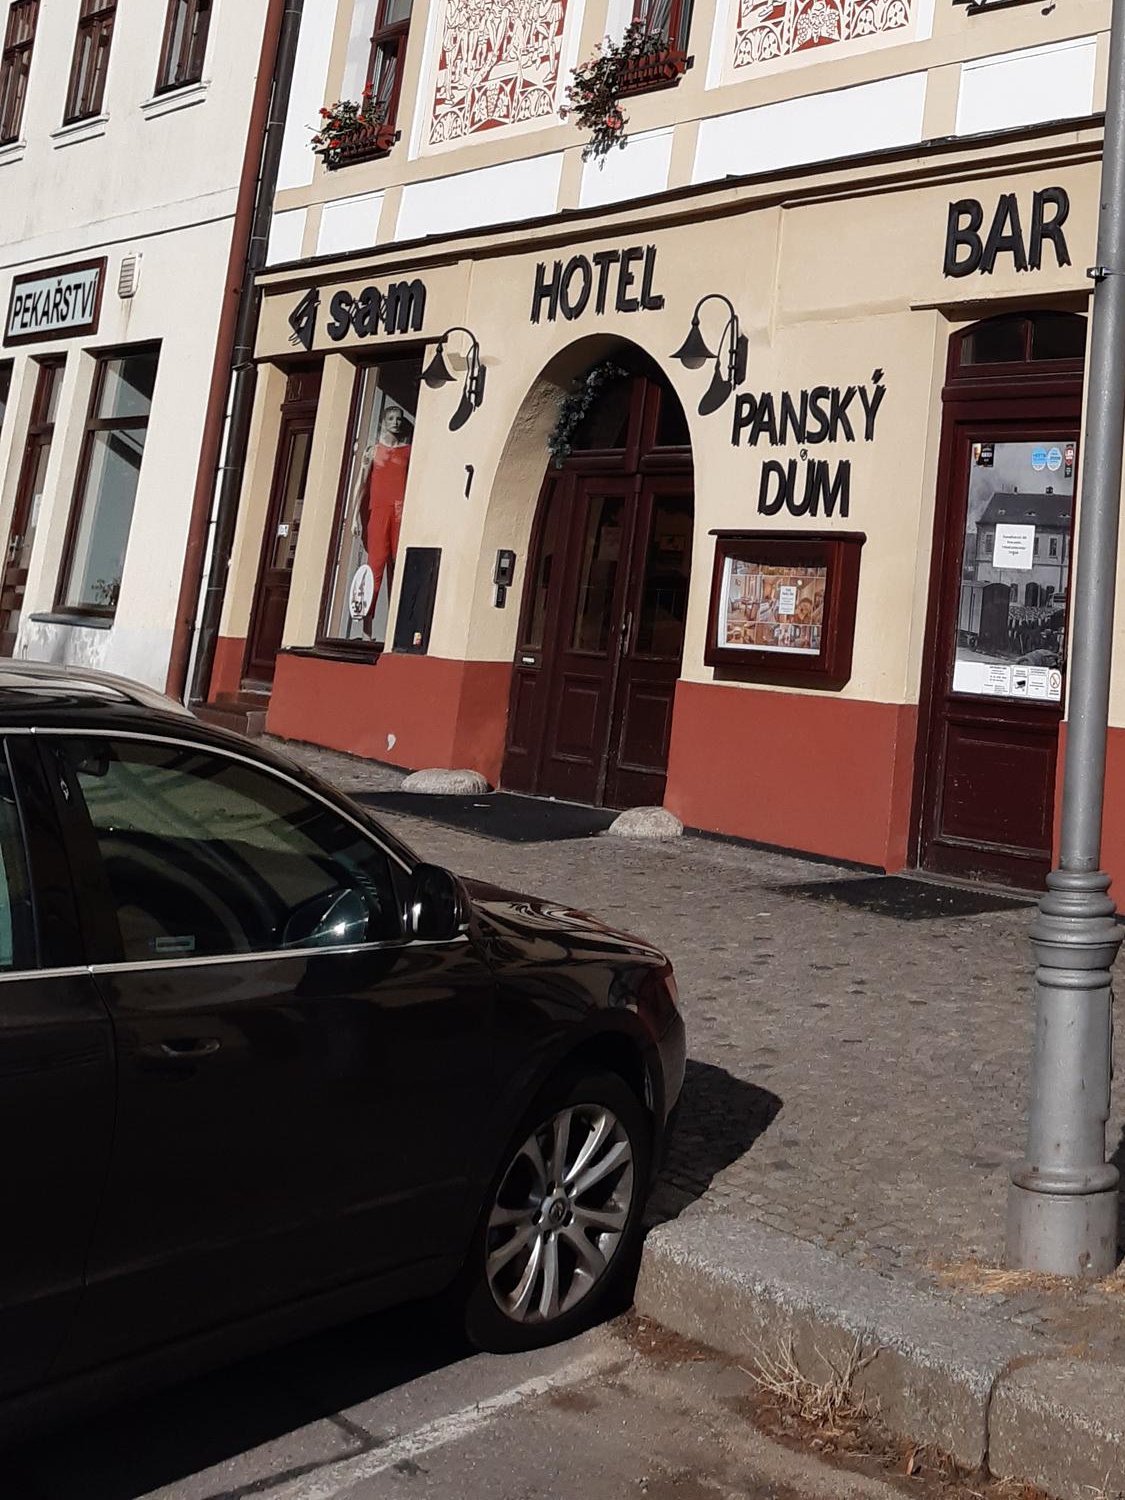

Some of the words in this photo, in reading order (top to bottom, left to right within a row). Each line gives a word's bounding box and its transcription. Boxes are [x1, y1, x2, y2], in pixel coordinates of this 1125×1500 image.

[943, 186, 1072, 278] BAR
[11, 270, 99, 331] PEKAŘSTVÍ
[327, 278, 427, 342] sam
[529, 244, 665, 324] HOTEL
[731, 368, 887, 447] PANSKÝ
[757, 448, 851, 518] DŮM
